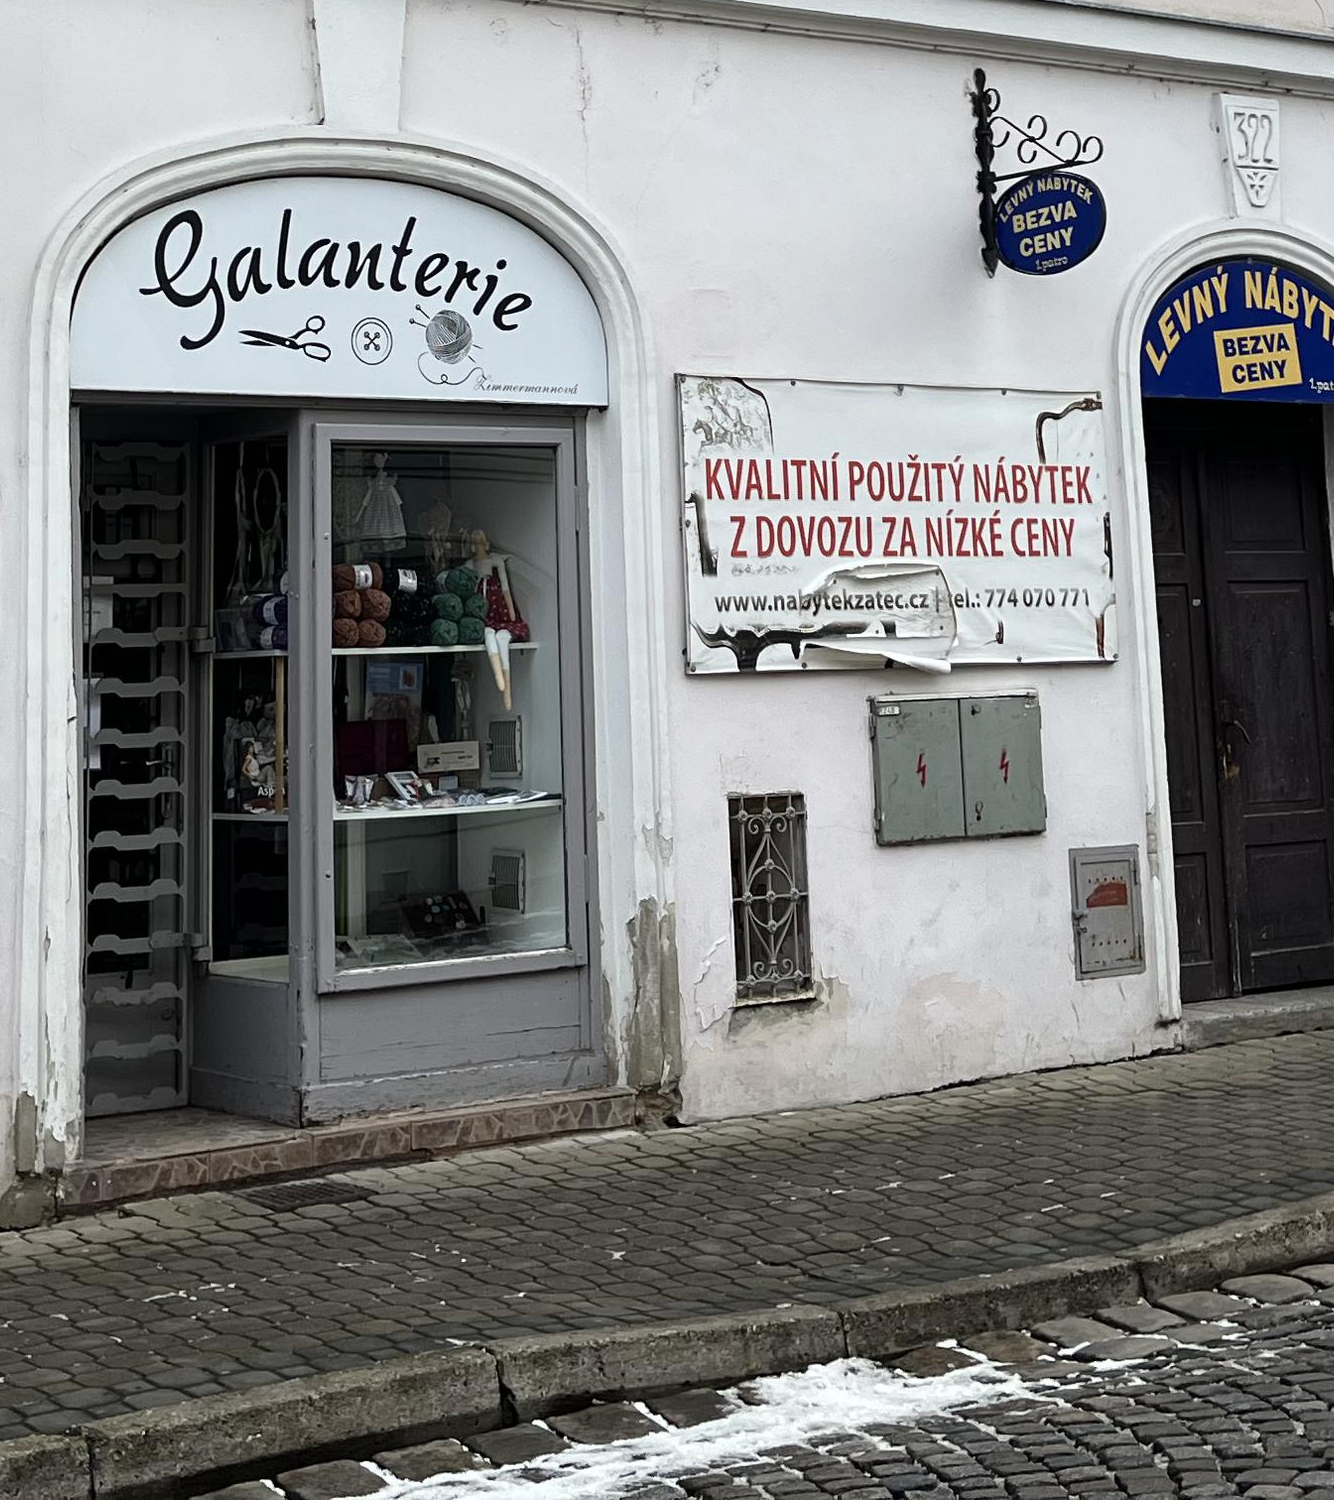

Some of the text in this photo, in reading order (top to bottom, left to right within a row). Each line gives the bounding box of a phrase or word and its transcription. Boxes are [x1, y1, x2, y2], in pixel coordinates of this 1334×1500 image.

[1233, 112, 1274, 163] 322
[1000, 175, 1093, 223] LEVNÝ NÁBYTEK
[1012, 200, 1077, 233] BEZVA
[1020, 226, 1074, 257] CENY
[140, 208, 534, 350] Galanterie
[1146, 266, 1229, 376] LEVNÝ
[1222, 333, 1290, 358] BEZVA
[1231, 360, 1287, 384] CENY
[705, 452, 1093, 504] KVALITNÍ POUŽITÝ NÁBYTEK
[729, 508, 1075, 558] Z DOVOZU ZA NÍZKÉ CENY
[716, 588, 929, 616] www.nabytekzatec.cz
[985, 589, 1018, 608] 774
[1023, 589, 1053, 607] 070
[1059, 588, 1090, 607] 771
